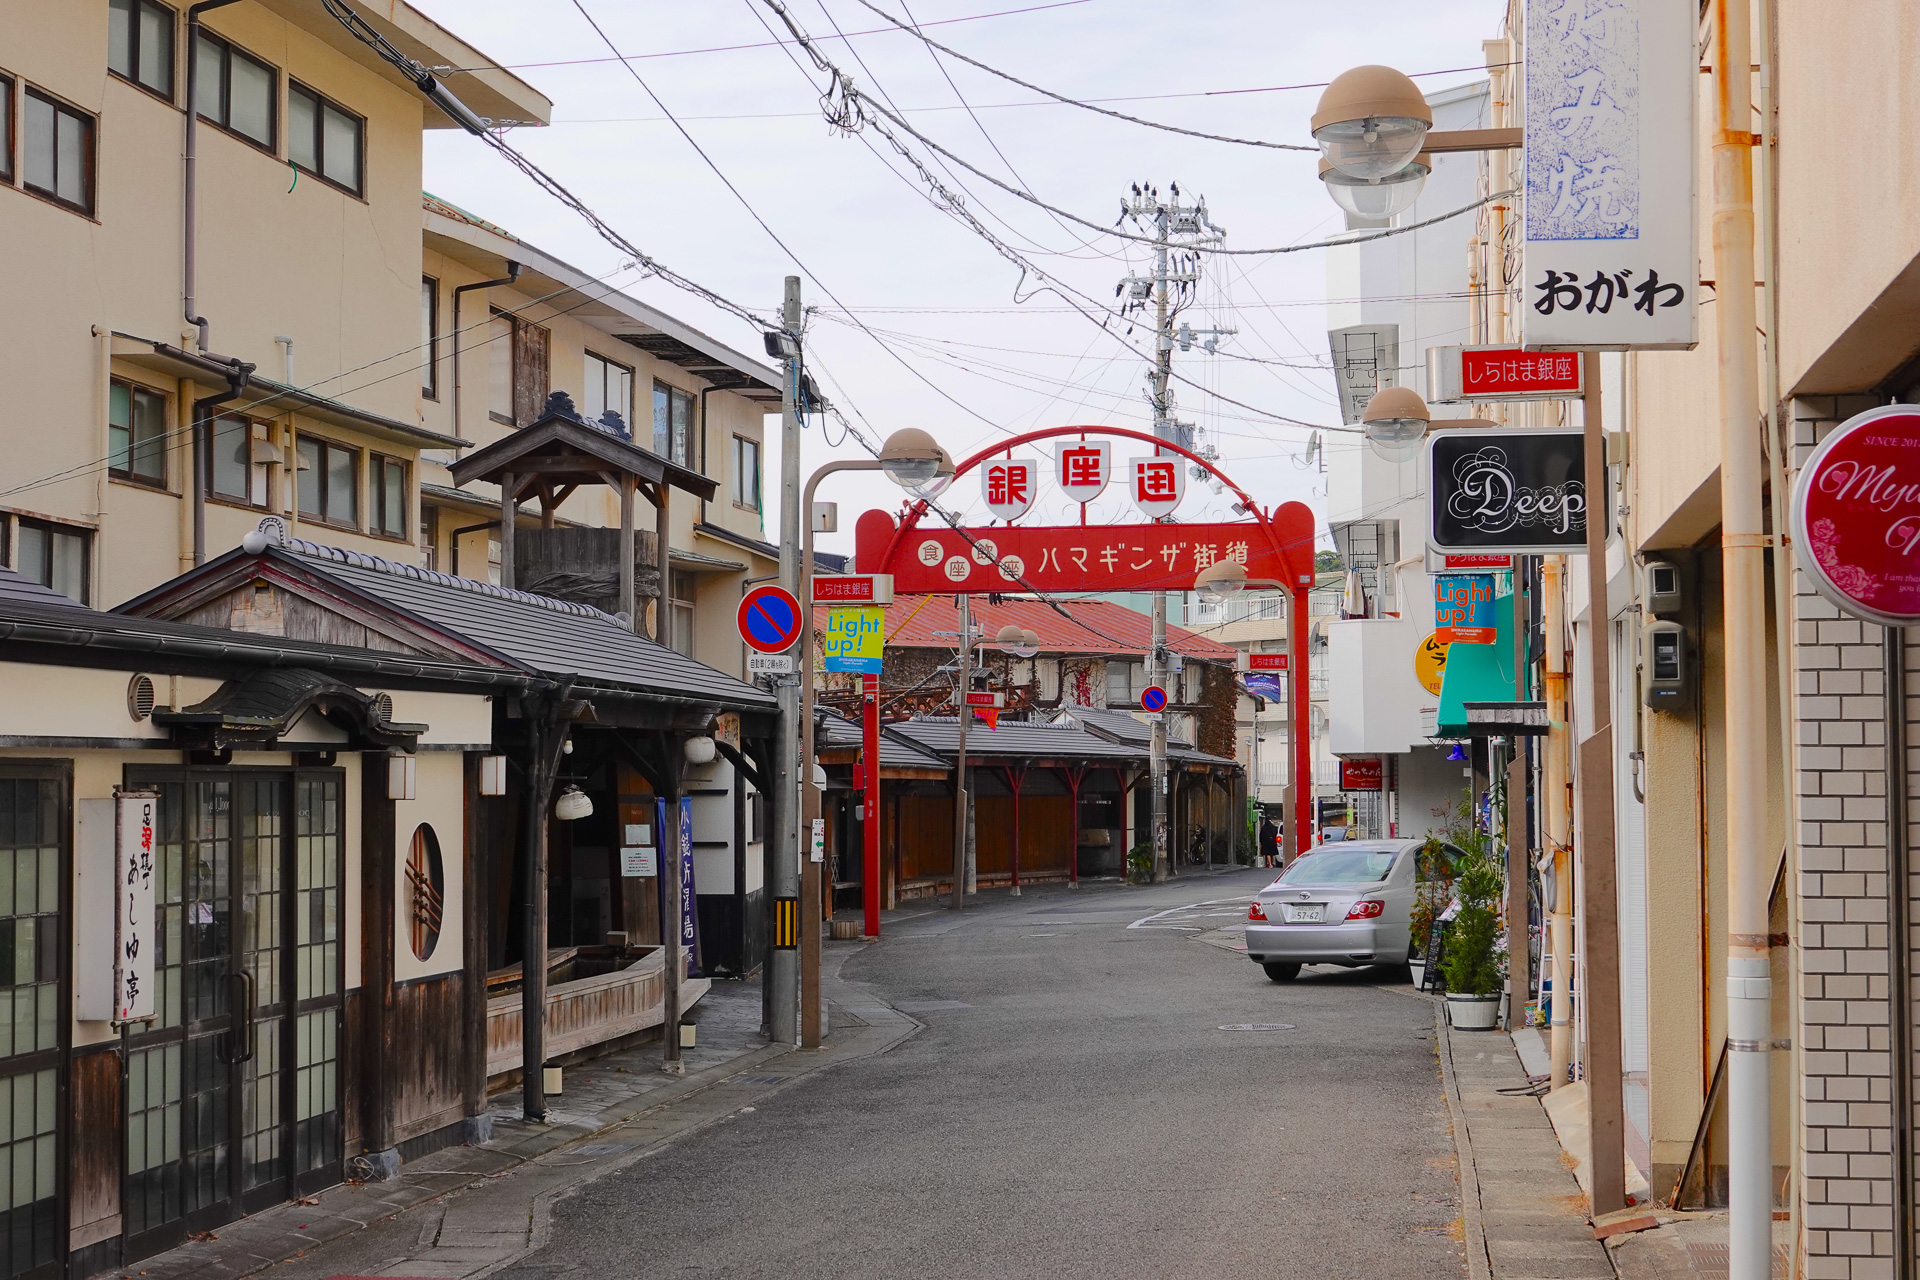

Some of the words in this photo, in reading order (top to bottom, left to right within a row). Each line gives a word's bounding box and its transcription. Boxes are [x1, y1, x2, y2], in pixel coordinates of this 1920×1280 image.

[1533, 268, 1685, 317] おがわ
[1468, 357, 1573, 384] しらはま銀座
[1863, 435, 1899, 447] SINCE
[1901, 437, 1920, 448] 201
[1455, 457, 1586, 534] Deep
[1038, 540, 1249, 574] ハマギンザ街道
[816, 583, 870, 596] しらはま銀座
[1436, 581, 1493, 607] Light
[828, 613, 881, 638] Light
[1436, 603, 1475, 627] up!
[827, 634, 863, 657] up!
[1251, 657, 1287, 667] しらはま銀座
[126, 852, 140, 1012] あしゆ亭
